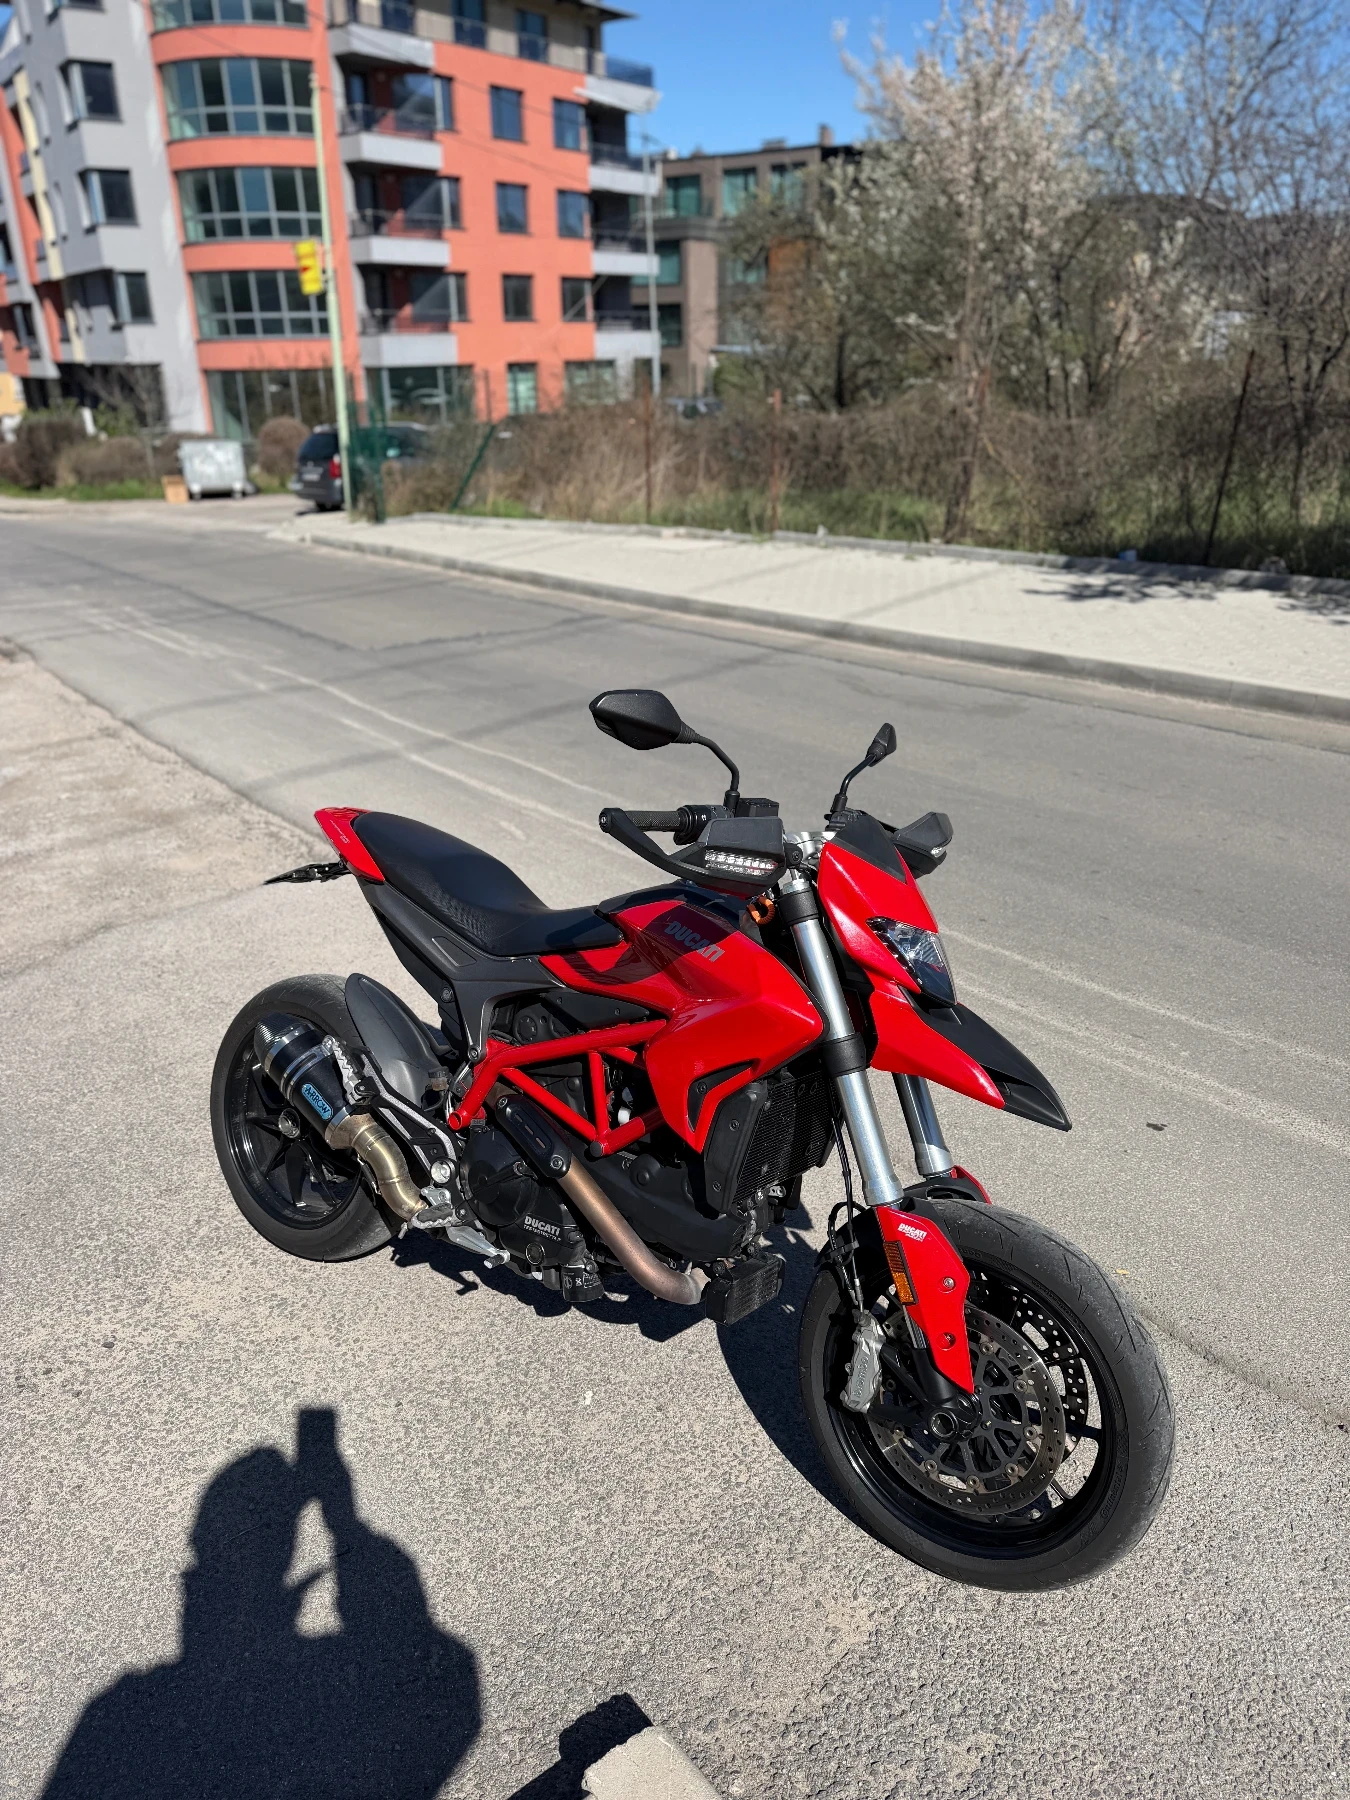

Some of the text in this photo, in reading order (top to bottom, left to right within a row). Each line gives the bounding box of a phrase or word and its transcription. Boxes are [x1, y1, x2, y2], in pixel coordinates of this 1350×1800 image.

[664, 920, 726, 963] DUCATI
[304, 1086, 331, 1114] ARROW
[524, 1215, 561, 1237] DUCATI
[898, 1222, 928, 1239] DUCATI
